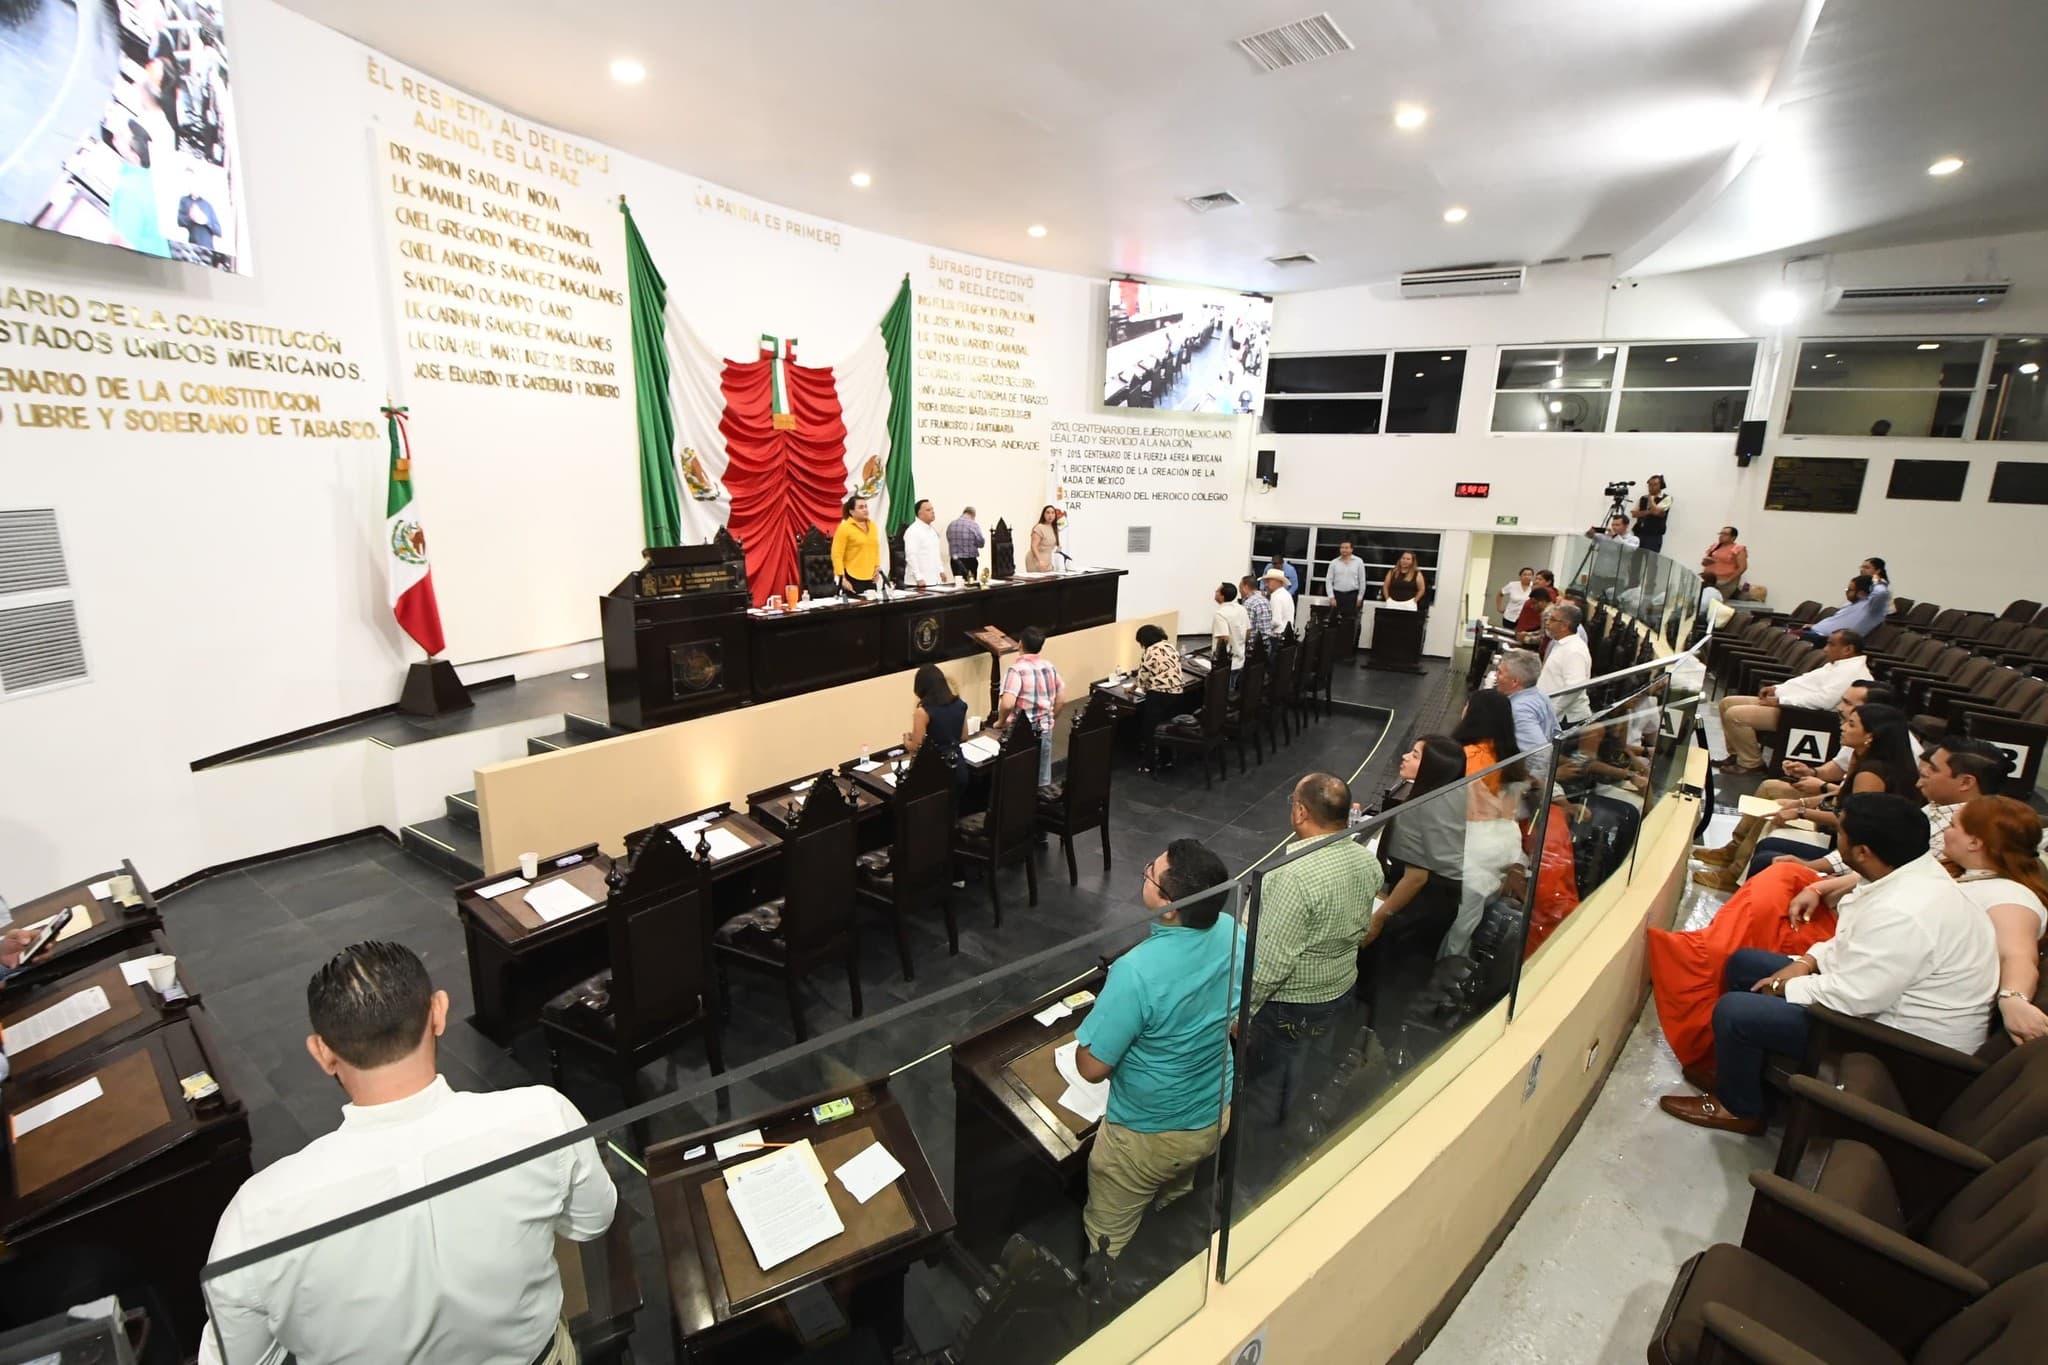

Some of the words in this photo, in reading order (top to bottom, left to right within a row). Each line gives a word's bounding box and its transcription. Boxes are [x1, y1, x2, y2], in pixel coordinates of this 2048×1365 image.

[367, 60, 394, 91] EL
[402, 76, 494, 131] RESPETO
[501, 118, 523, 142] AL
[528, 128, 609, 174] DERECHO
[414, 110, 486, 155] AJENO,
[492, 139, 516, 163] ES
[523, 150, 543, 174] LA
[550, 162, 581, 187] PAZ
[389, 142, 411, 165] DR
[417, 151, 461, 180] SIMON
[467, 169, 520, 198] SARLAT
[527, 187, 561, 213] NOVA
[392, 173, 416, 198] LIC
[420, 182, 476, 216] MANUEL
[482, 201, 541, 233] SANCHEZ
[546, 220, 593, 248] MARMOL
[695, 192, 712, 208] LA
[716, 197, 761, 225] PATRIA
[764, 213, 781, 230] ES
[785, 220, 841, 246] PRIMERO
[395, 206, 433, 233] CNEL
[436, 218, 503, 248] GREGORIO
[507, 236, 555, 264] MENDEZ
[400, 239, 437, 264] CNEL
[441, 249, 496, 276] ANDRES
[500, 263, 555, 290] SANCHEZ
[558, 278, 624, 306] MAGALLANES
[928, 255, 982, 278] SUFRAGIO
[986, 269, 1034, 288] EFECTIVO
[937, 277, 954, 290] NO
[959, 280, 1025, 303] REELECCION
[403, 270, 475, 300] SANTIAGO
[478, 287, 533, 313] OCAMPO
[539, 299, 574, 321] CANO
[0, 286, 80, 319] ARIO
[88, 300, 128, 326] DE
[130, 305, 170, 331] LA
[176, 313, 342, 355] CONSTITUCIÓN
[404, 299, 424, 320] LIC
[427, 304, 481, 329] CARMEN
[485, 315, 541, 340] SANCHEZ
[545, 327, 613, 352] MAGALLANES
[124, 336, 217, 365] UNIDOS
[227, 349, 366, 382] MEXICANOS.
[408, 330, 431, 352] LIC
[569, 356, 616, 378] ESCOBAR
[97, 376, 130, 400] DE
[137, 379, 171, 403] LA
[180, 381, 321, 413] CONSTITUCION
[449, 364, 502, 387] EDUARDO
[506, 373, 519, 389] DE
[522, 373, 573, 395] CARDENAS
[584, 380, 620, 400] ROMERO
[14, 403, 90, 430] LIBRE
[98, 407, 114, 431] Y
[124, 409, 249, 435] SOBERANO
[256, 416, 283, 436] DE
[290, 416, 381, 440] TABASCO.
[1050, 432, 1090, 444] LEALTAD
[1099, 436, 1138, 446] SERVICIO
[1147, 439, 1158, 447] LA
[1072, 423, 1125, 435] CENTENARIO
[1127, 426, 1142, 436] DEL
[953, 437, 997, 448] ROVIROSA
[1002, 440, 1041, 451] ANDRADE
[1084, 449, 1121, 460] CENTENARIO
[1123, 451, 1132, 460] DE
[1133, 452, 1142, 460] LA
[1143, 452, 1167, 461] FUERZA
[1192, 454, 1223, 463] MEXICANA
[1070, 464, 1124, 474] BICENTENARIO
[1126, 466, 1136, 475] DE
[1138, 467, 1148, 475] LA
[1192, 469, 1202, 477] DE
[1204, 469, 1215, 478] LA
[1085, 476, 1095, 485] DE
[1065, 501, 1082, 510] TAR
[1070, 490, 1132, 500] BICENTENARIO
[1133, 491, 1149, 500] DEL
[1151, 492, 1189, 501] HEROICO
[1191, 492, 1229, 502] COLEGIO
[1791, 734, 1822, 760] A
